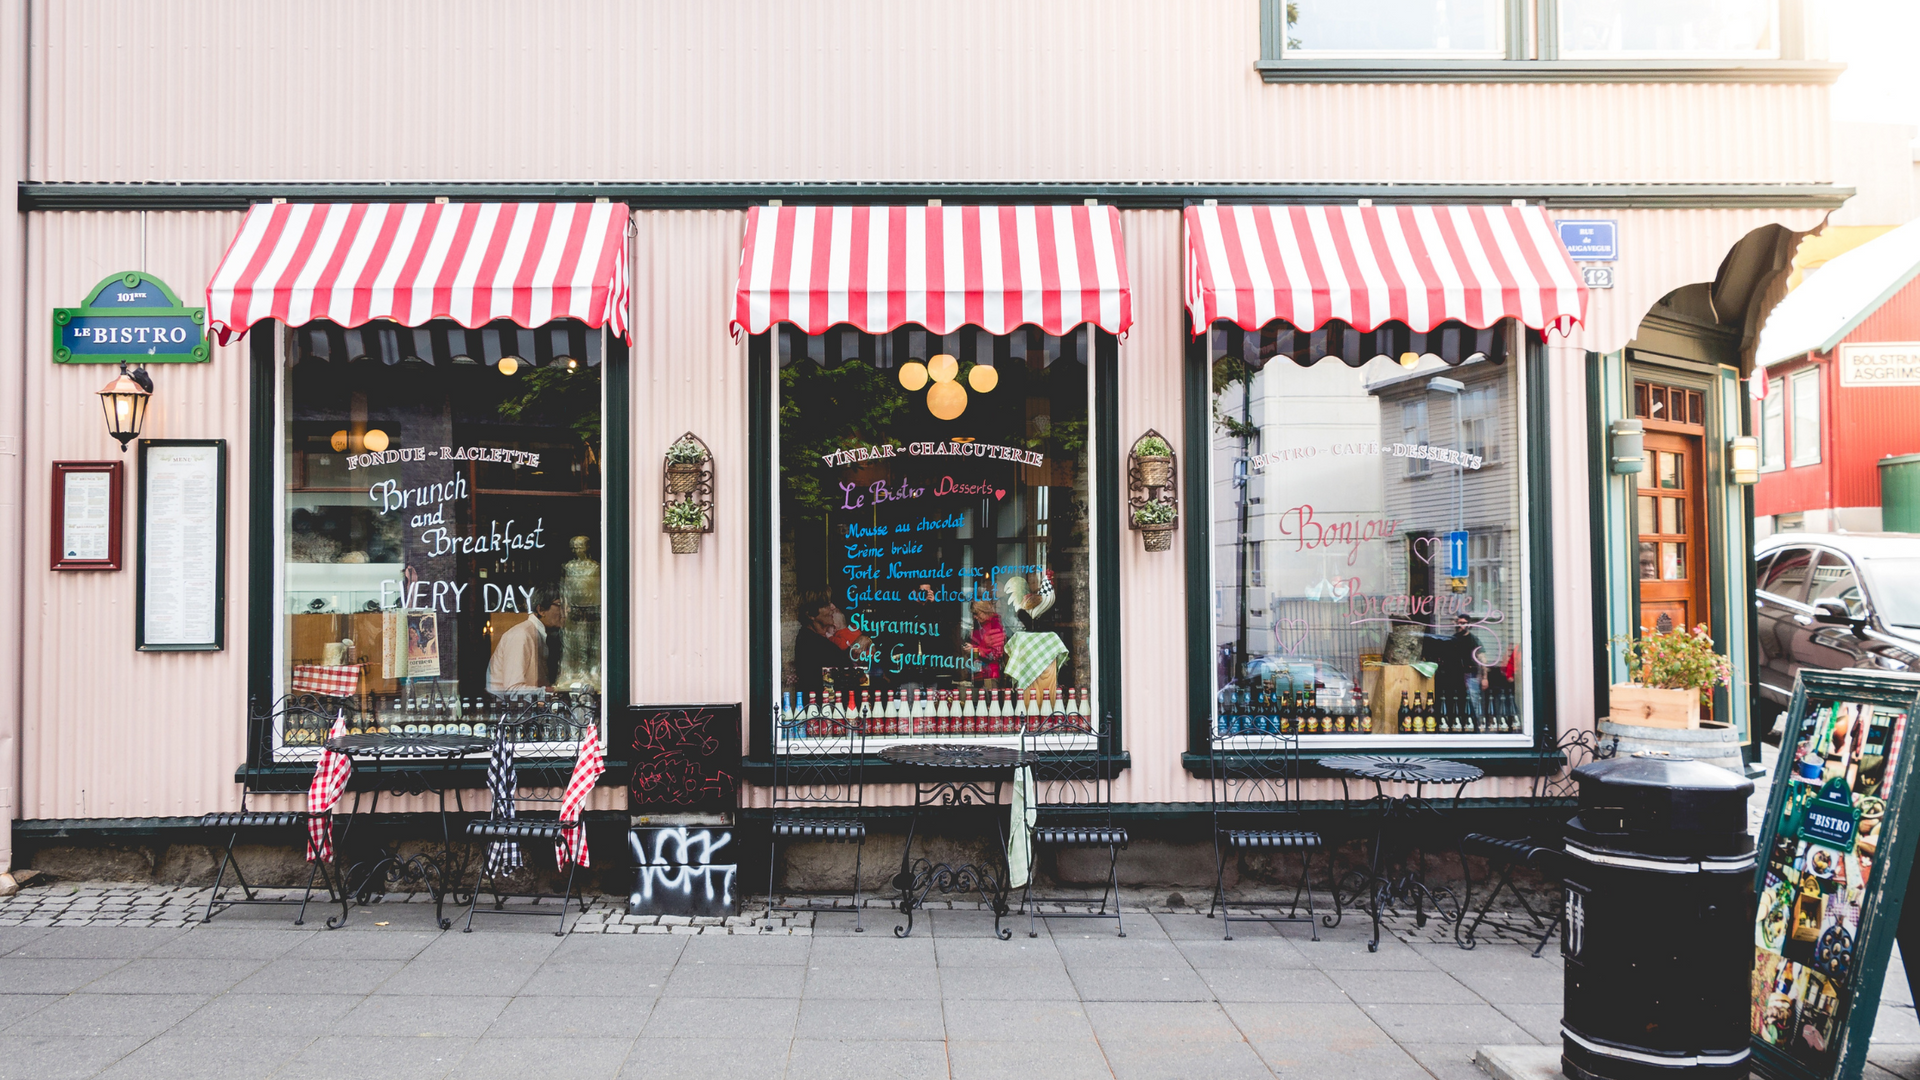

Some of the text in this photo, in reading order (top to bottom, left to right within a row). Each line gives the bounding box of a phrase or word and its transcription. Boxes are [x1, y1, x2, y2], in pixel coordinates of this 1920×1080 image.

[1587, 270, 1609, 285] 12
[74, 327, 187, 343] LE BISTRO
[346, 446, 540, 470] FONDUE RACLETTE
[909, 441, 1044, 467] CHARCUTERIE
[1251, 440, 1483, 470] BISTRO CAFÉ DESSERTS
[369, 471, 468, 515] Brunch
[839, 475, 993, 510] Le Bistro Desserts
[410, 503, 445, 528] and
[845, 513, 966, 539] Mousse au chocolat
[421, 517, 545, 563] Breakfast
[1279, 504, 1404, 566] Bonjour
[844, 544, 884, 559] Crème
[842, 561, 1044, 586] Torte Normande aux pommes
[380, 579, 535, 614] EVERY DAY
[846, 581, 1000, 610] Gateau au chocolat
[1333, 577, 1472, 618] Bienvenue
[848, 612, 940, 638] Skyramisu
[849, 642, 977, 673] Café Gourmand
[1815, 814, 1850, 833] BISTRO
